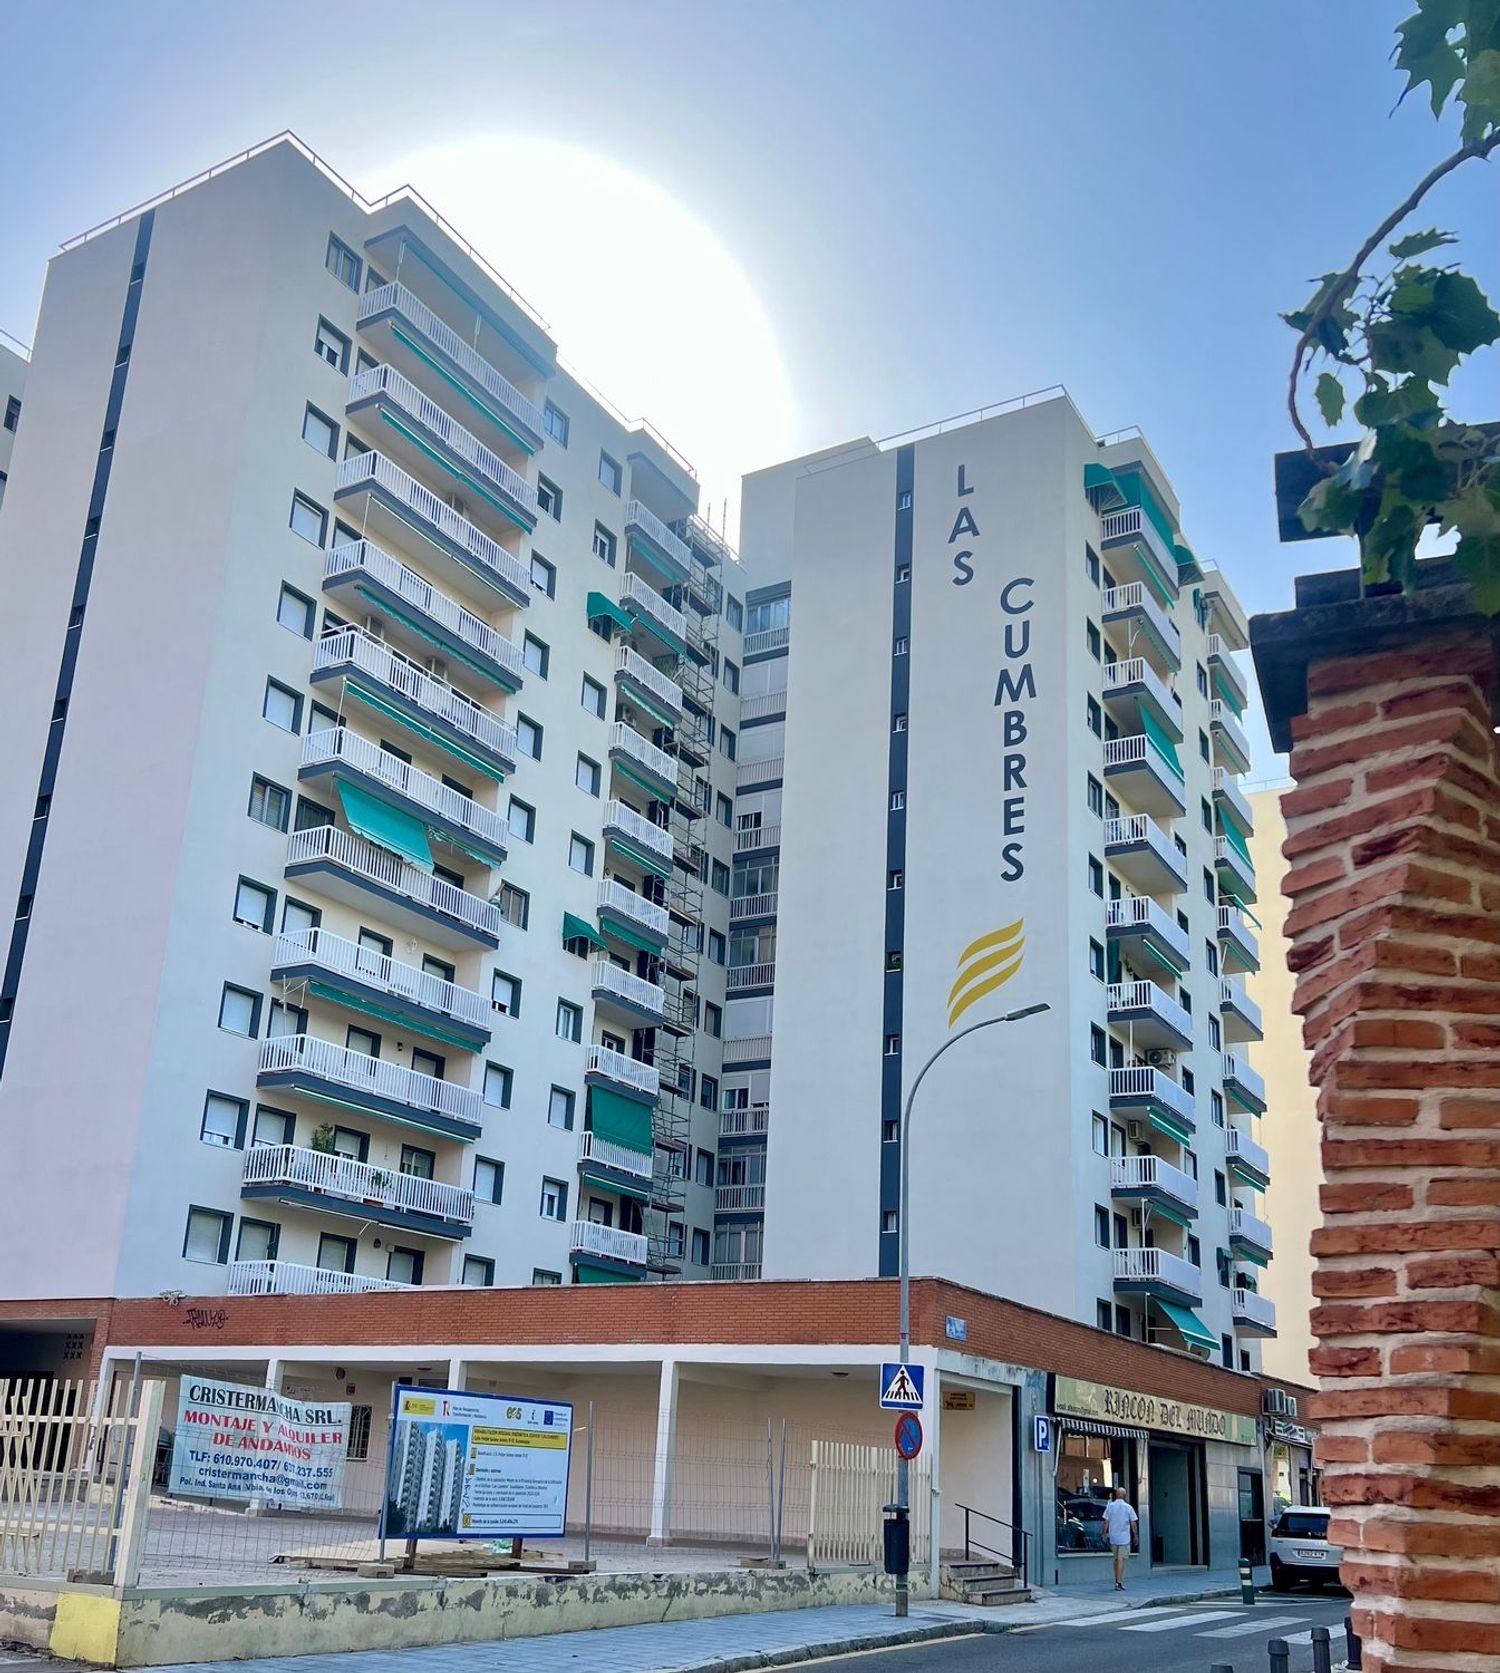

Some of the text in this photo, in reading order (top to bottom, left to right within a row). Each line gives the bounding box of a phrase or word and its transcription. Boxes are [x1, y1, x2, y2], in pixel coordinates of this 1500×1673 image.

[948, 464, 980, 586] LAS
[994, 577, 1037, 882] CUMBRES
[184, 1410, 342, 1443] MONTAJE Y ALQUILER
[305, 1409, 342, 1425] SRL.
[1159, 1402, 1182, 1428] DEL
[189, 1450, 211, 1463] TLF:
[213, 1432, 311, 1460] DE ANDAMIOS
[199, 1466, 327, 1490] cristermancha@gmail.com
